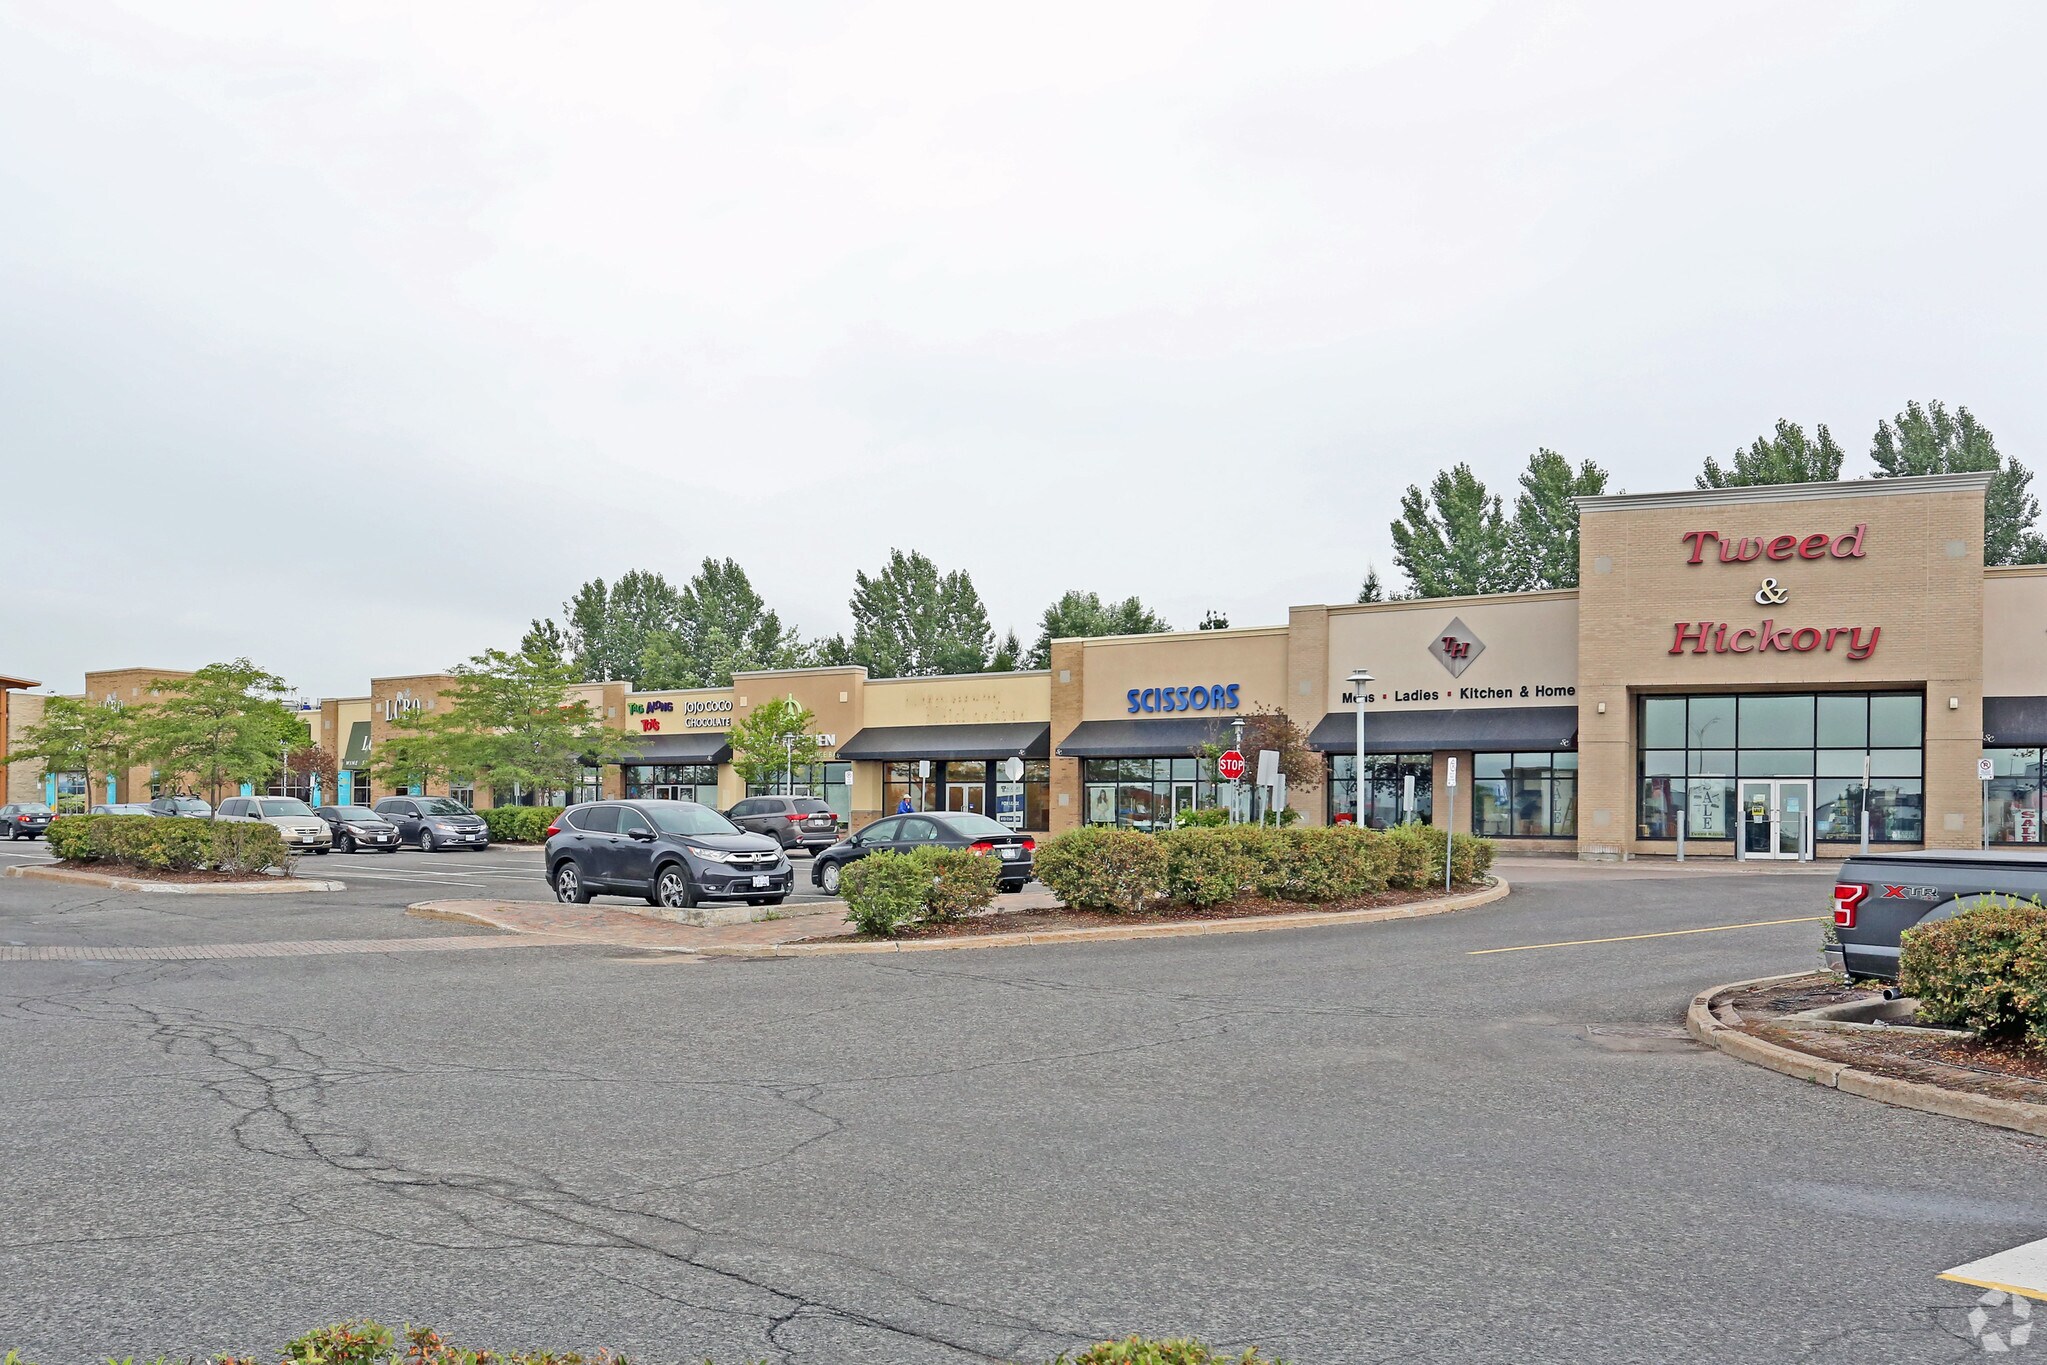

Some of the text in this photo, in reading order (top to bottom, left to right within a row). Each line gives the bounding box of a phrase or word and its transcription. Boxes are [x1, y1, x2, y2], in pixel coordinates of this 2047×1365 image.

[1682, 523, 1867, 564] Tweed
[1755, 577, 1789, 605] &
[1668, 619, 1882, 660] Hickory
[1127, 683, 1240, 714] SCISSORS
[1395, 689, 1439, 702] Ladies
[1460, 685, 1512, 699] Kitchen
[1520, 685, 1529, 697] &
[1535, 684, 1576, 697] Home
[685, 717, 731, 728] CHOCOLATE
[1220, 759, 1243, 771] STOP
[2021, 811, 2036, 843] SALE
[1881, 884, 1938, 899] XTR
